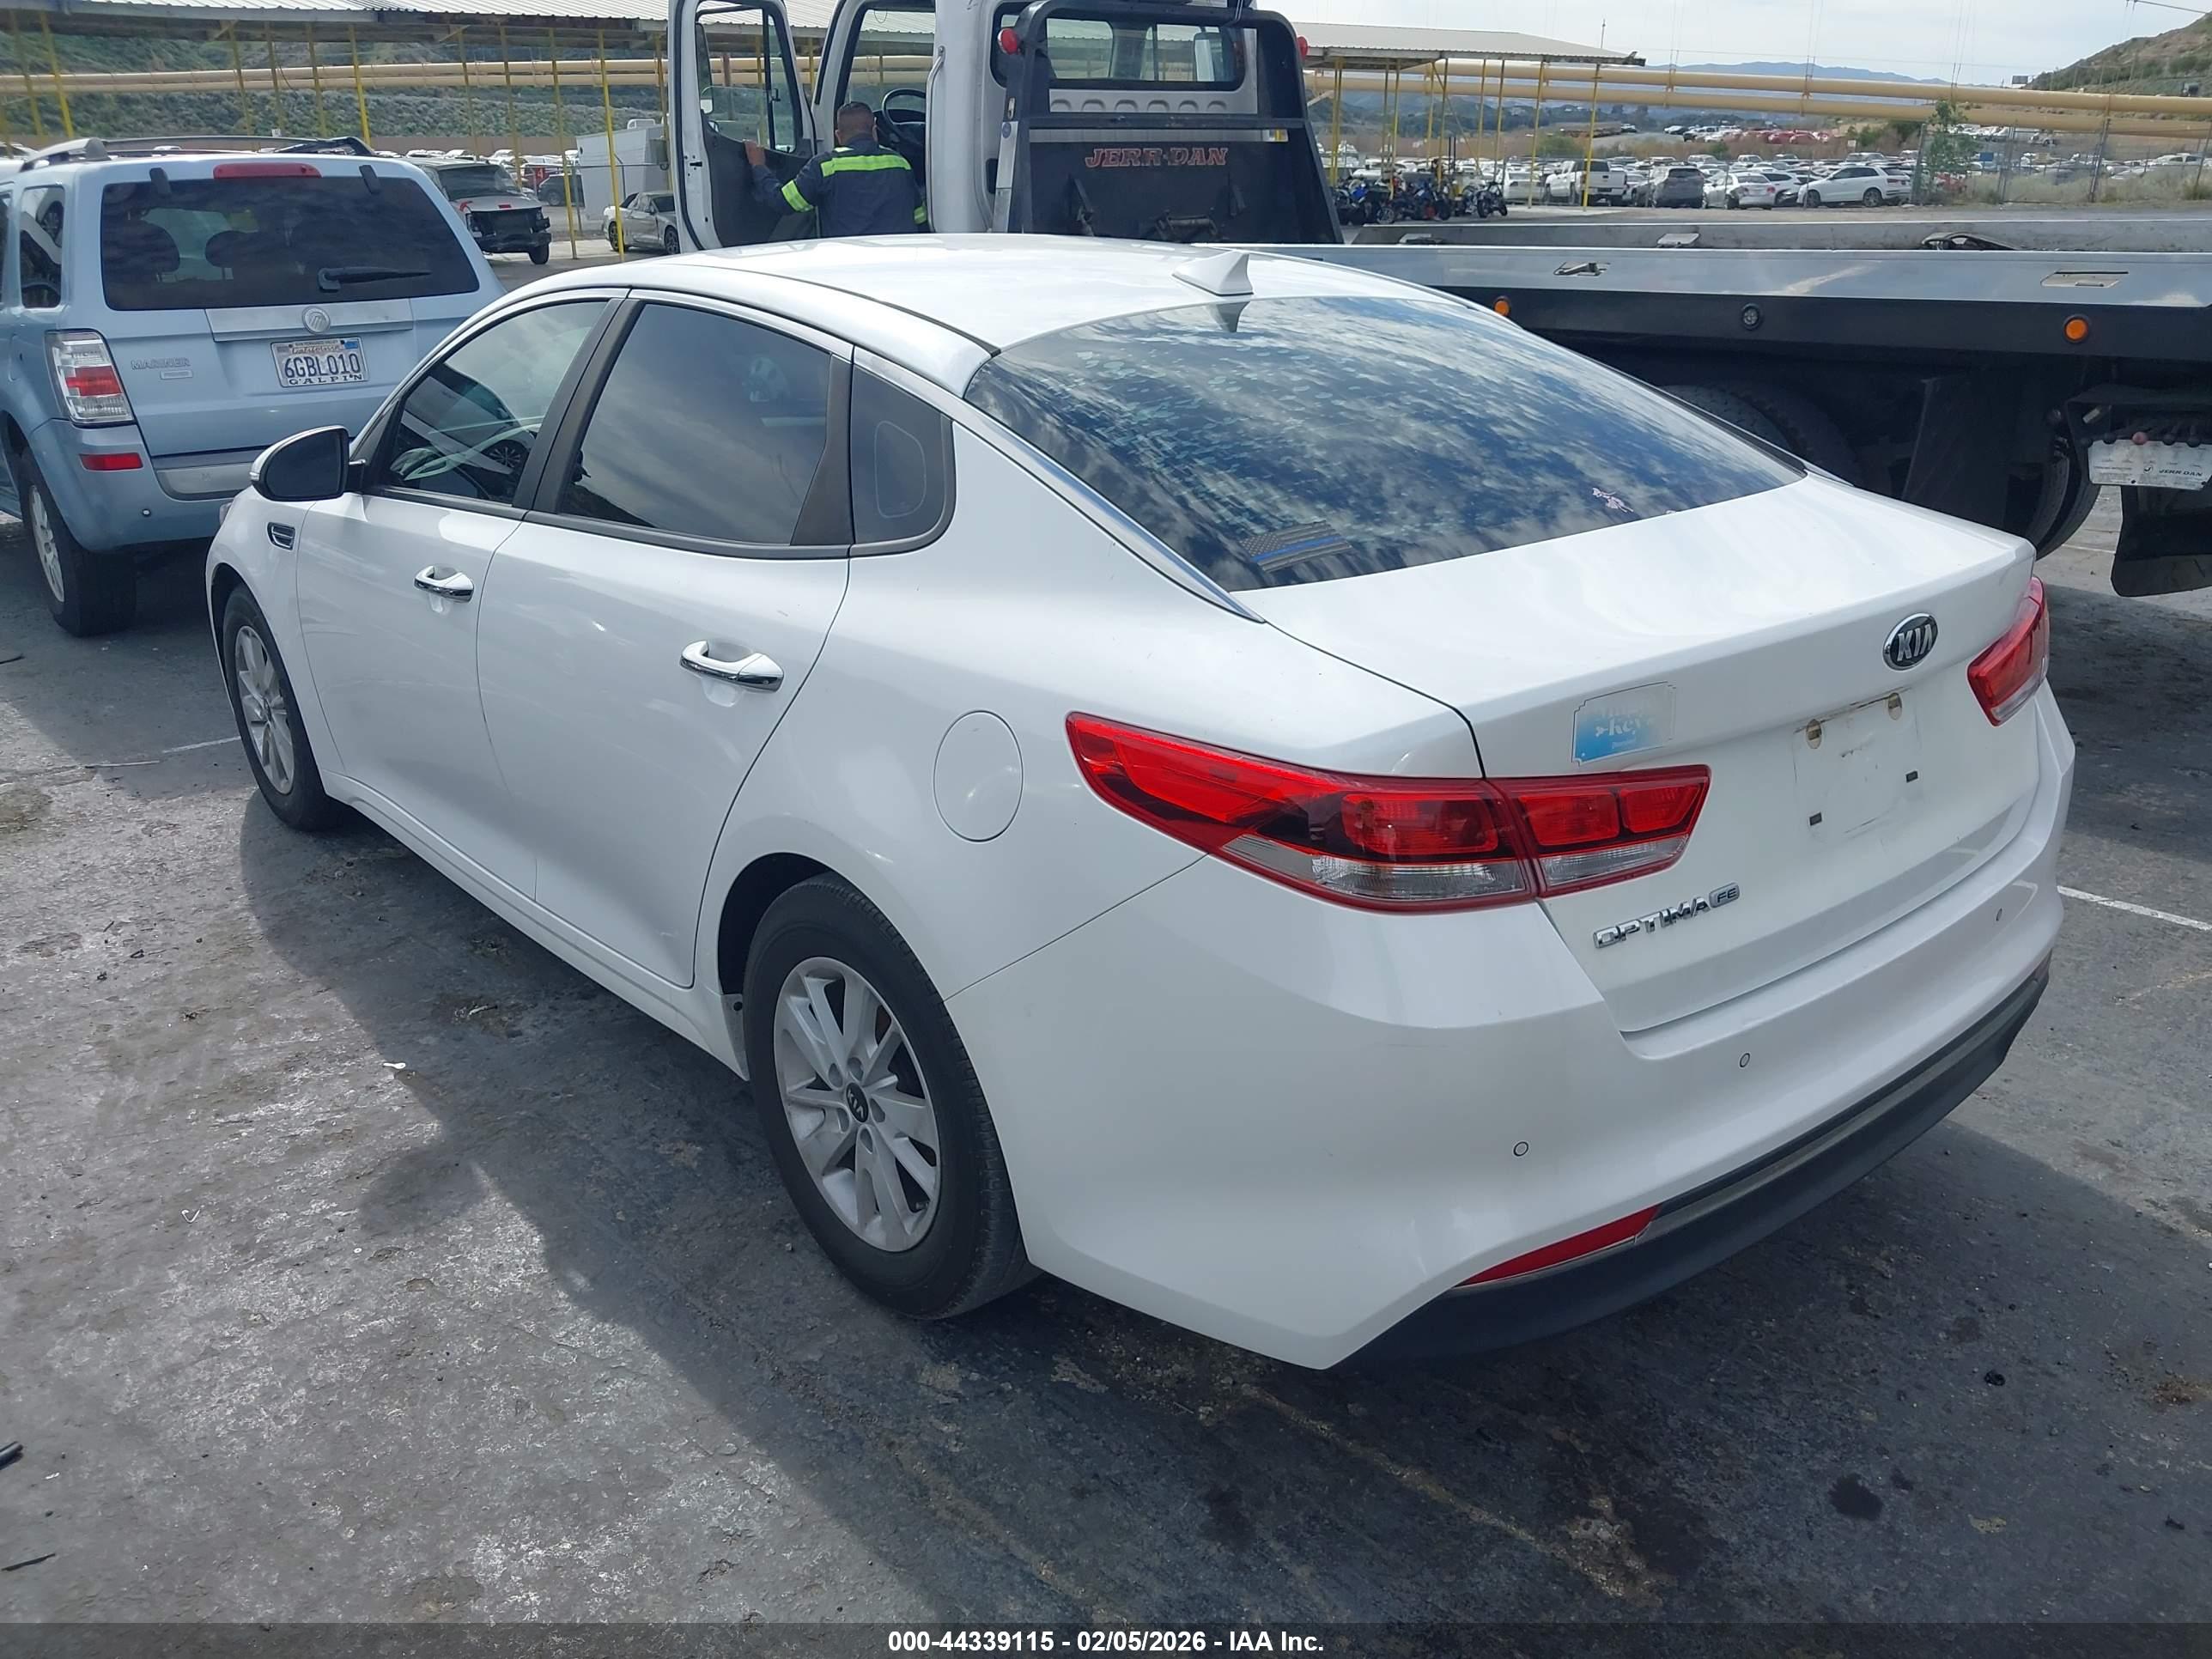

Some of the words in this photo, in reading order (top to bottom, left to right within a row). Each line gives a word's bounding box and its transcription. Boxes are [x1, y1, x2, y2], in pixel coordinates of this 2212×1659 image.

[284, 353, 361, 378] 6GBL010
[1896, 623, 1933, 662] KIA
[1593, 896, 1711, 949] OPTIMA
[1717, 887, 1738, 903] FE
